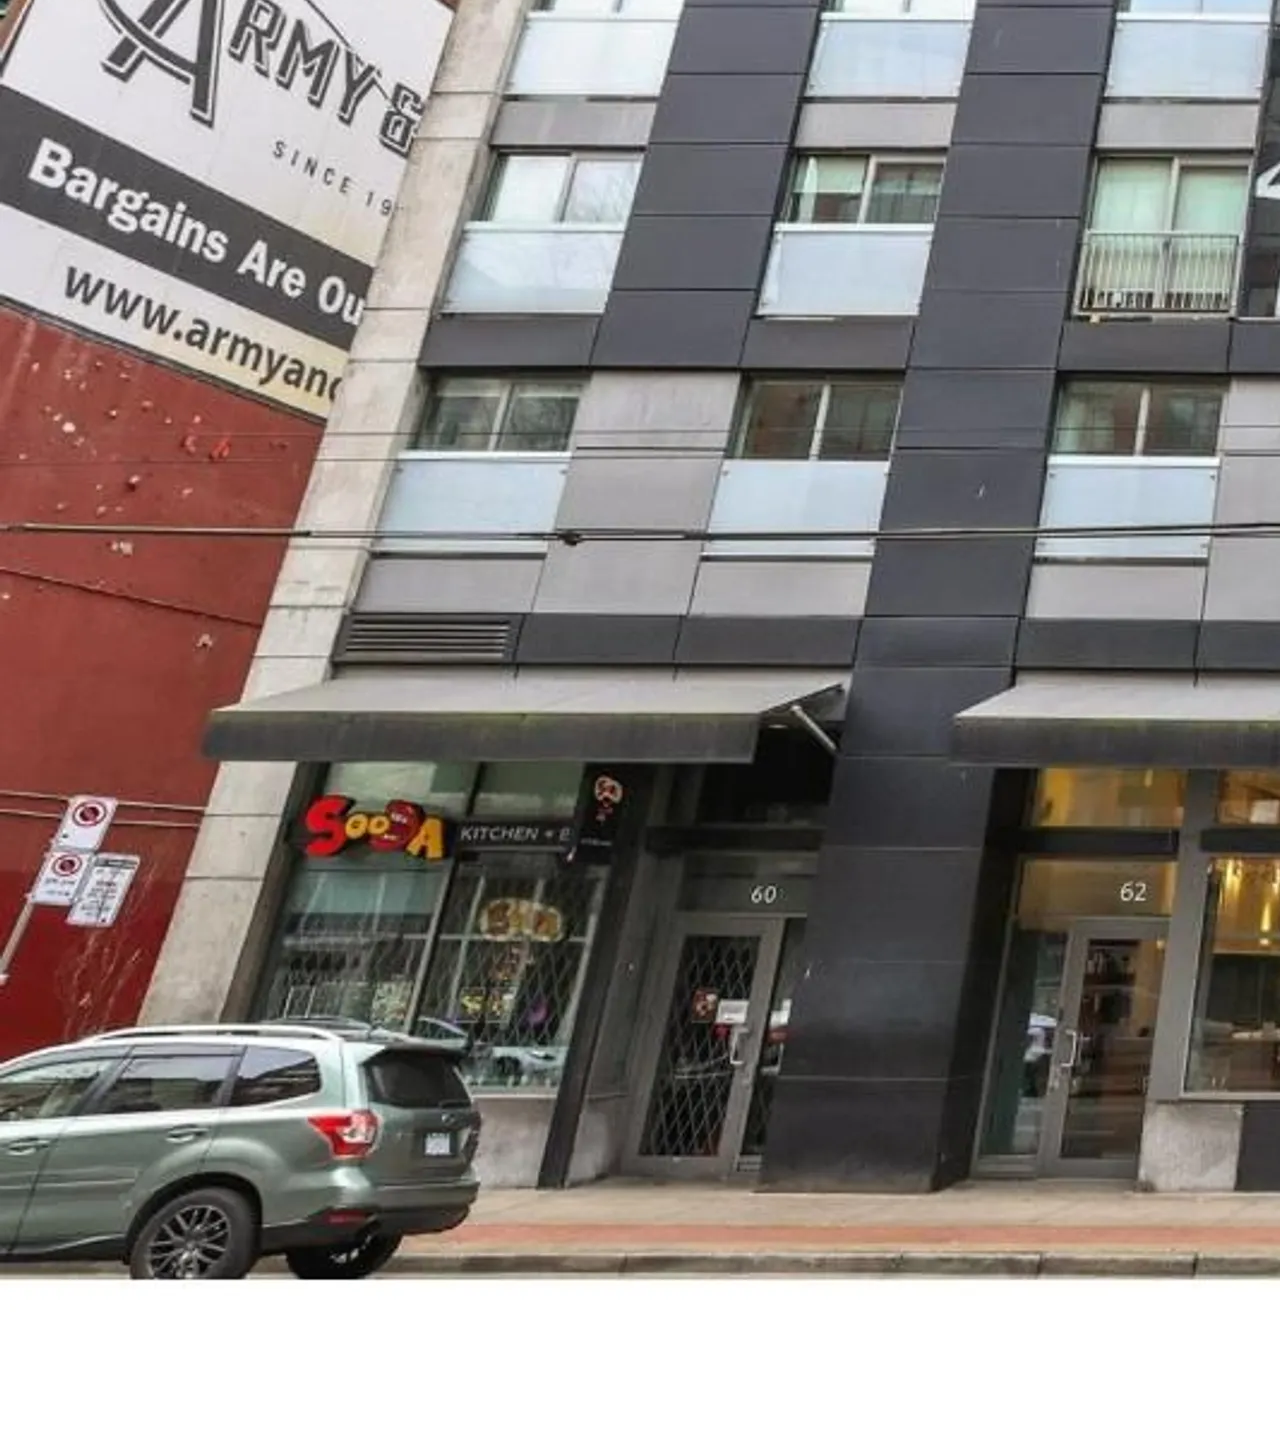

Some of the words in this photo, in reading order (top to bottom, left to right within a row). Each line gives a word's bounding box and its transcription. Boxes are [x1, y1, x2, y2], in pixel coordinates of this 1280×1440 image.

[379, 81, 423, 158] &
[272, 139, 353, 194] SINCE
[27, 137, 229, 263] Bargains
[237, 239, 308, 299] Are
[317, 275, 367, 327] Ou
[460, 826, 539, 842] KITCHEN
[751, 885, 777, 904] 60
[1120, 880, 1147, 902] 62
